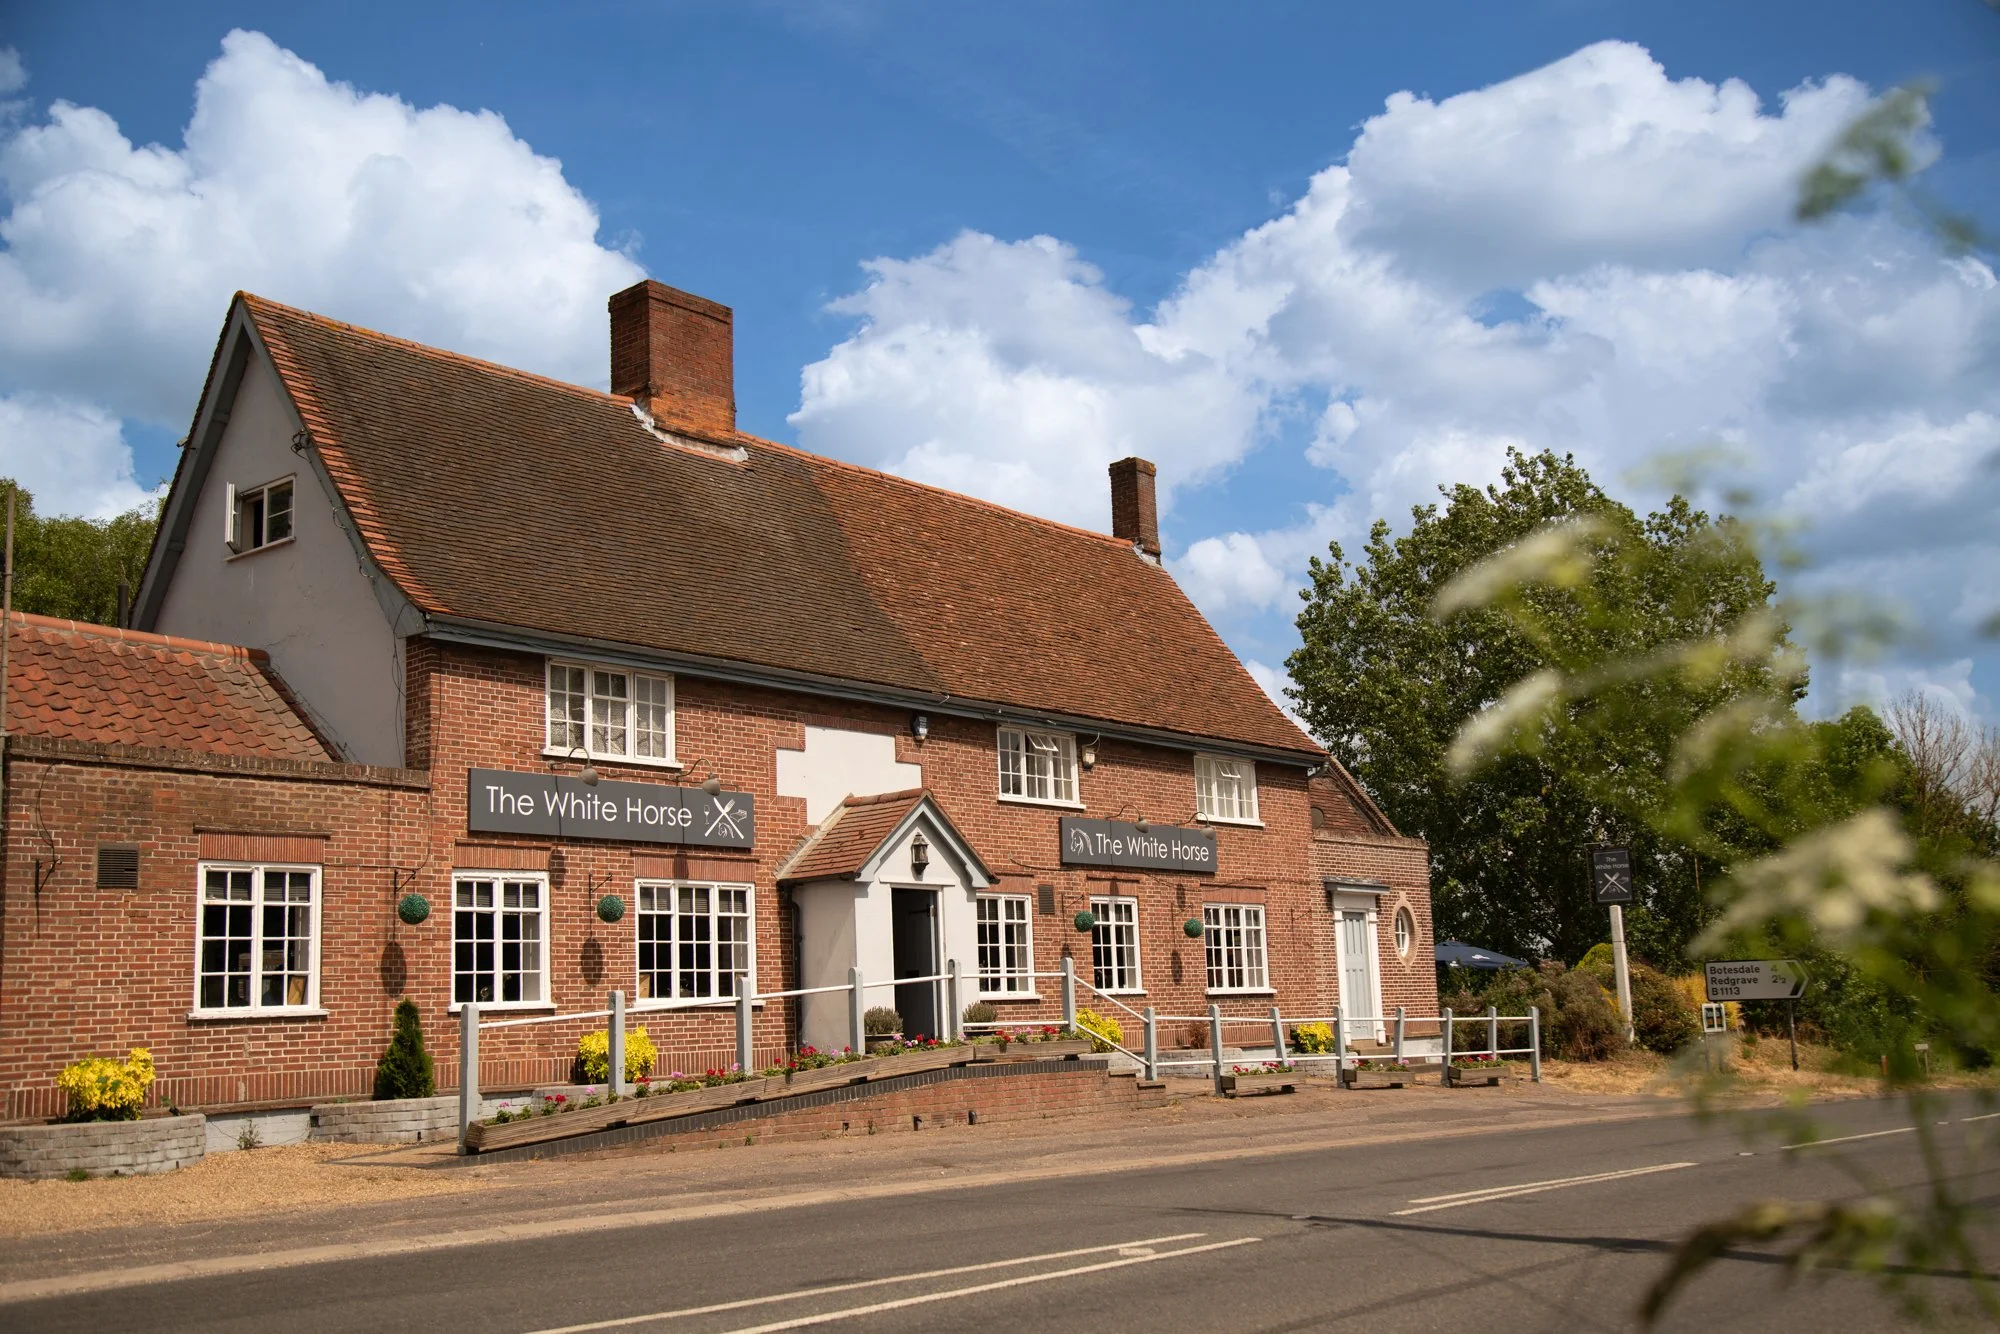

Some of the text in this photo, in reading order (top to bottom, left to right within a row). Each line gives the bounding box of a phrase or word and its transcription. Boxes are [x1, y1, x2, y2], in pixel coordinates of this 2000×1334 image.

[486, 785, 692, 827] The White Horse
[1096, 833, 1209, 861] The White Horse
[1709, 966, 1760, 975] Botesdale
[1711, 976, 1758, 986] Redgrave
